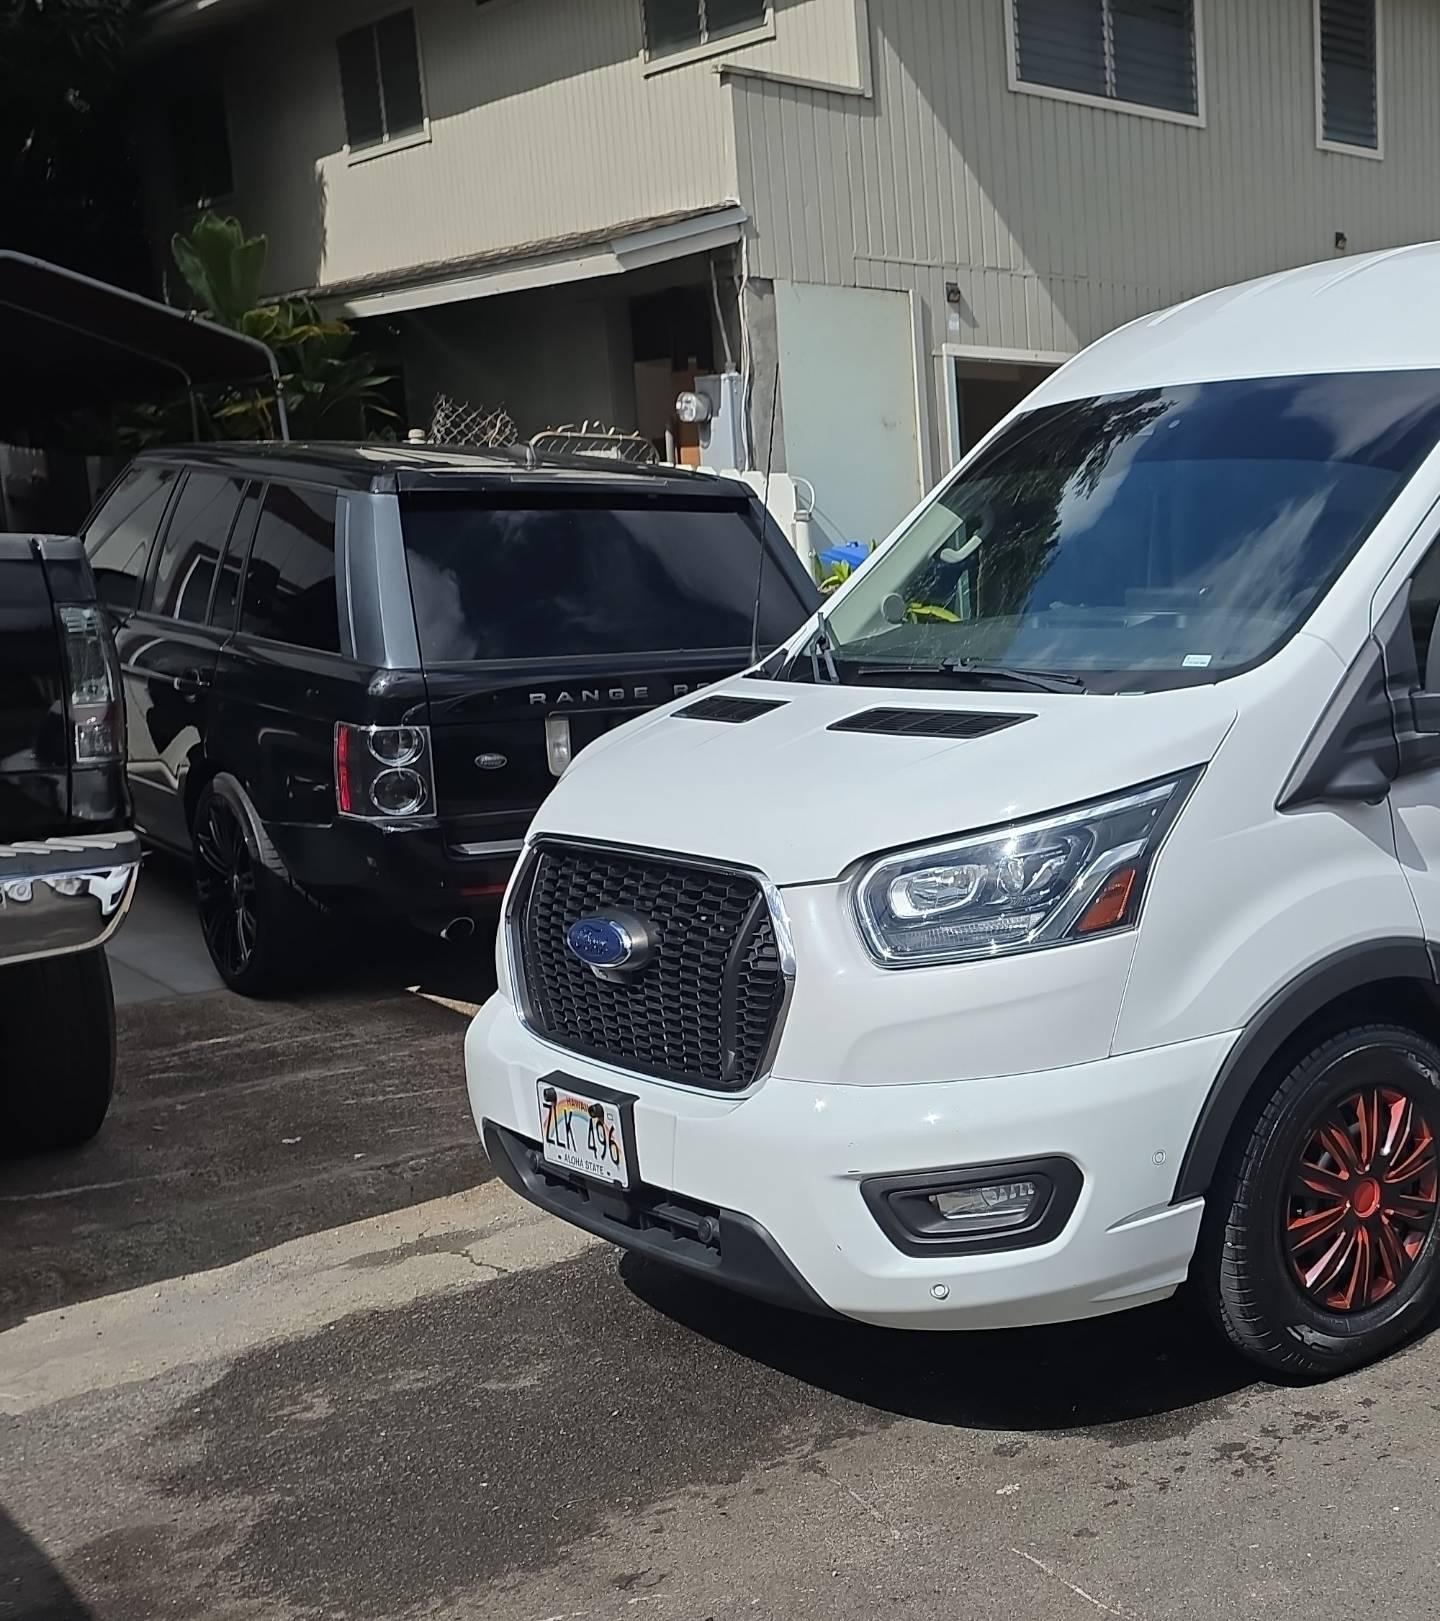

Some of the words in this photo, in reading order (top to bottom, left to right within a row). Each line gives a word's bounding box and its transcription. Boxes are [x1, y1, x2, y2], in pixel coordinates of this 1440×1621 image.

[529, 687, 649, 705] RANGE
[543, 1103, 577, 1152] ZLK
[588, 1117, 620, 1167] 496
[564, 1153, 584, 1169] ALOHA
[585, 1160, 604, 1175] STATE
